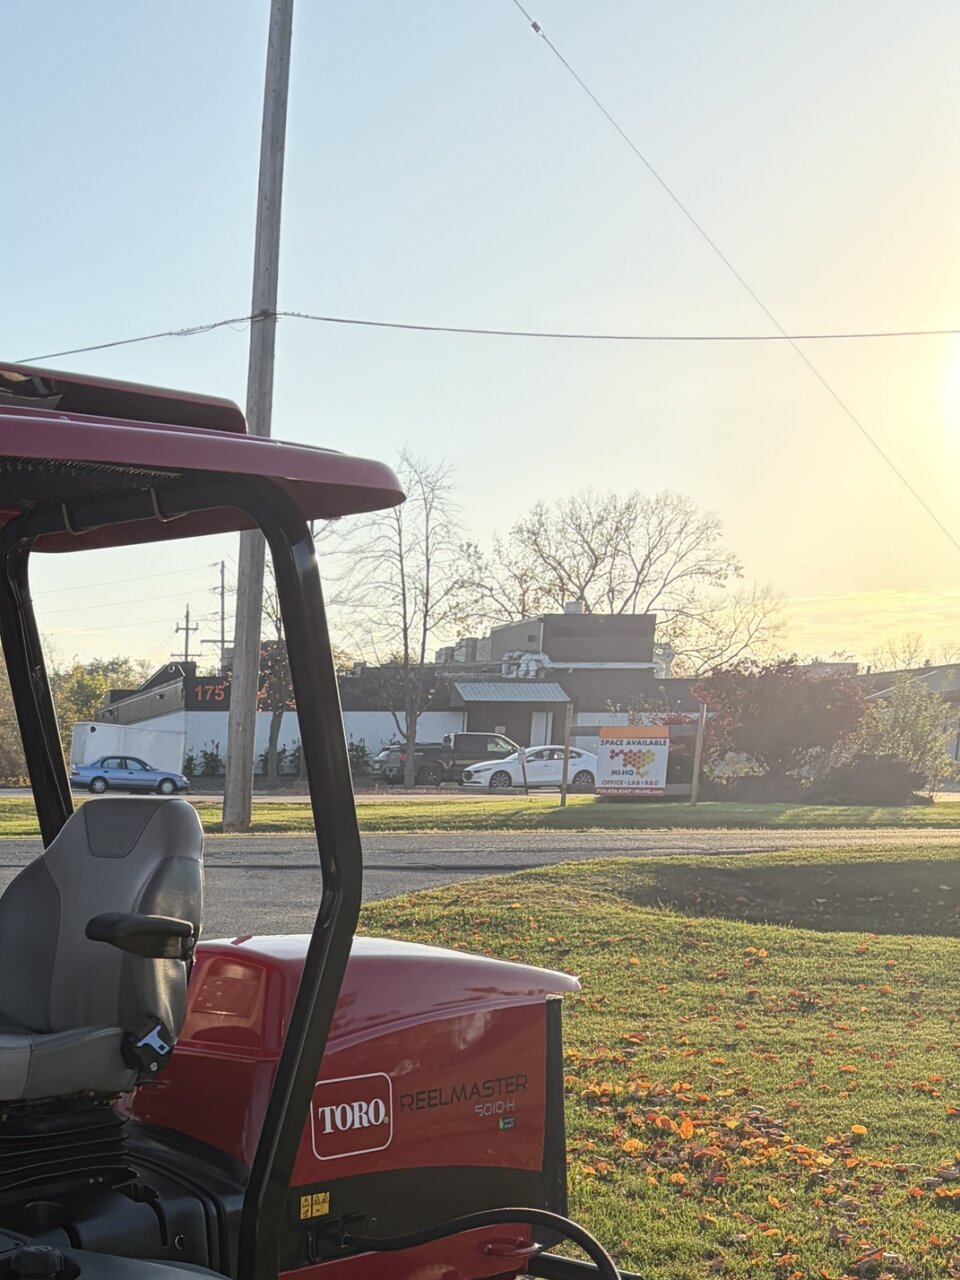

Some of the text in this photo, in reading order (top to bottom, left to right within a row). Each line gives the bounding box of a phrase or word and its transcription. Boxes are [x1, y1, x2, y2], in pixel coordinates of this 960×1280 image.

[194, 685, 225, 701] 175
[400, 1074, 528, 1112] REELMASTER
[318, 1098, 385, 1134] TORO
[475, 1099, 516, 1117] 5010-H
